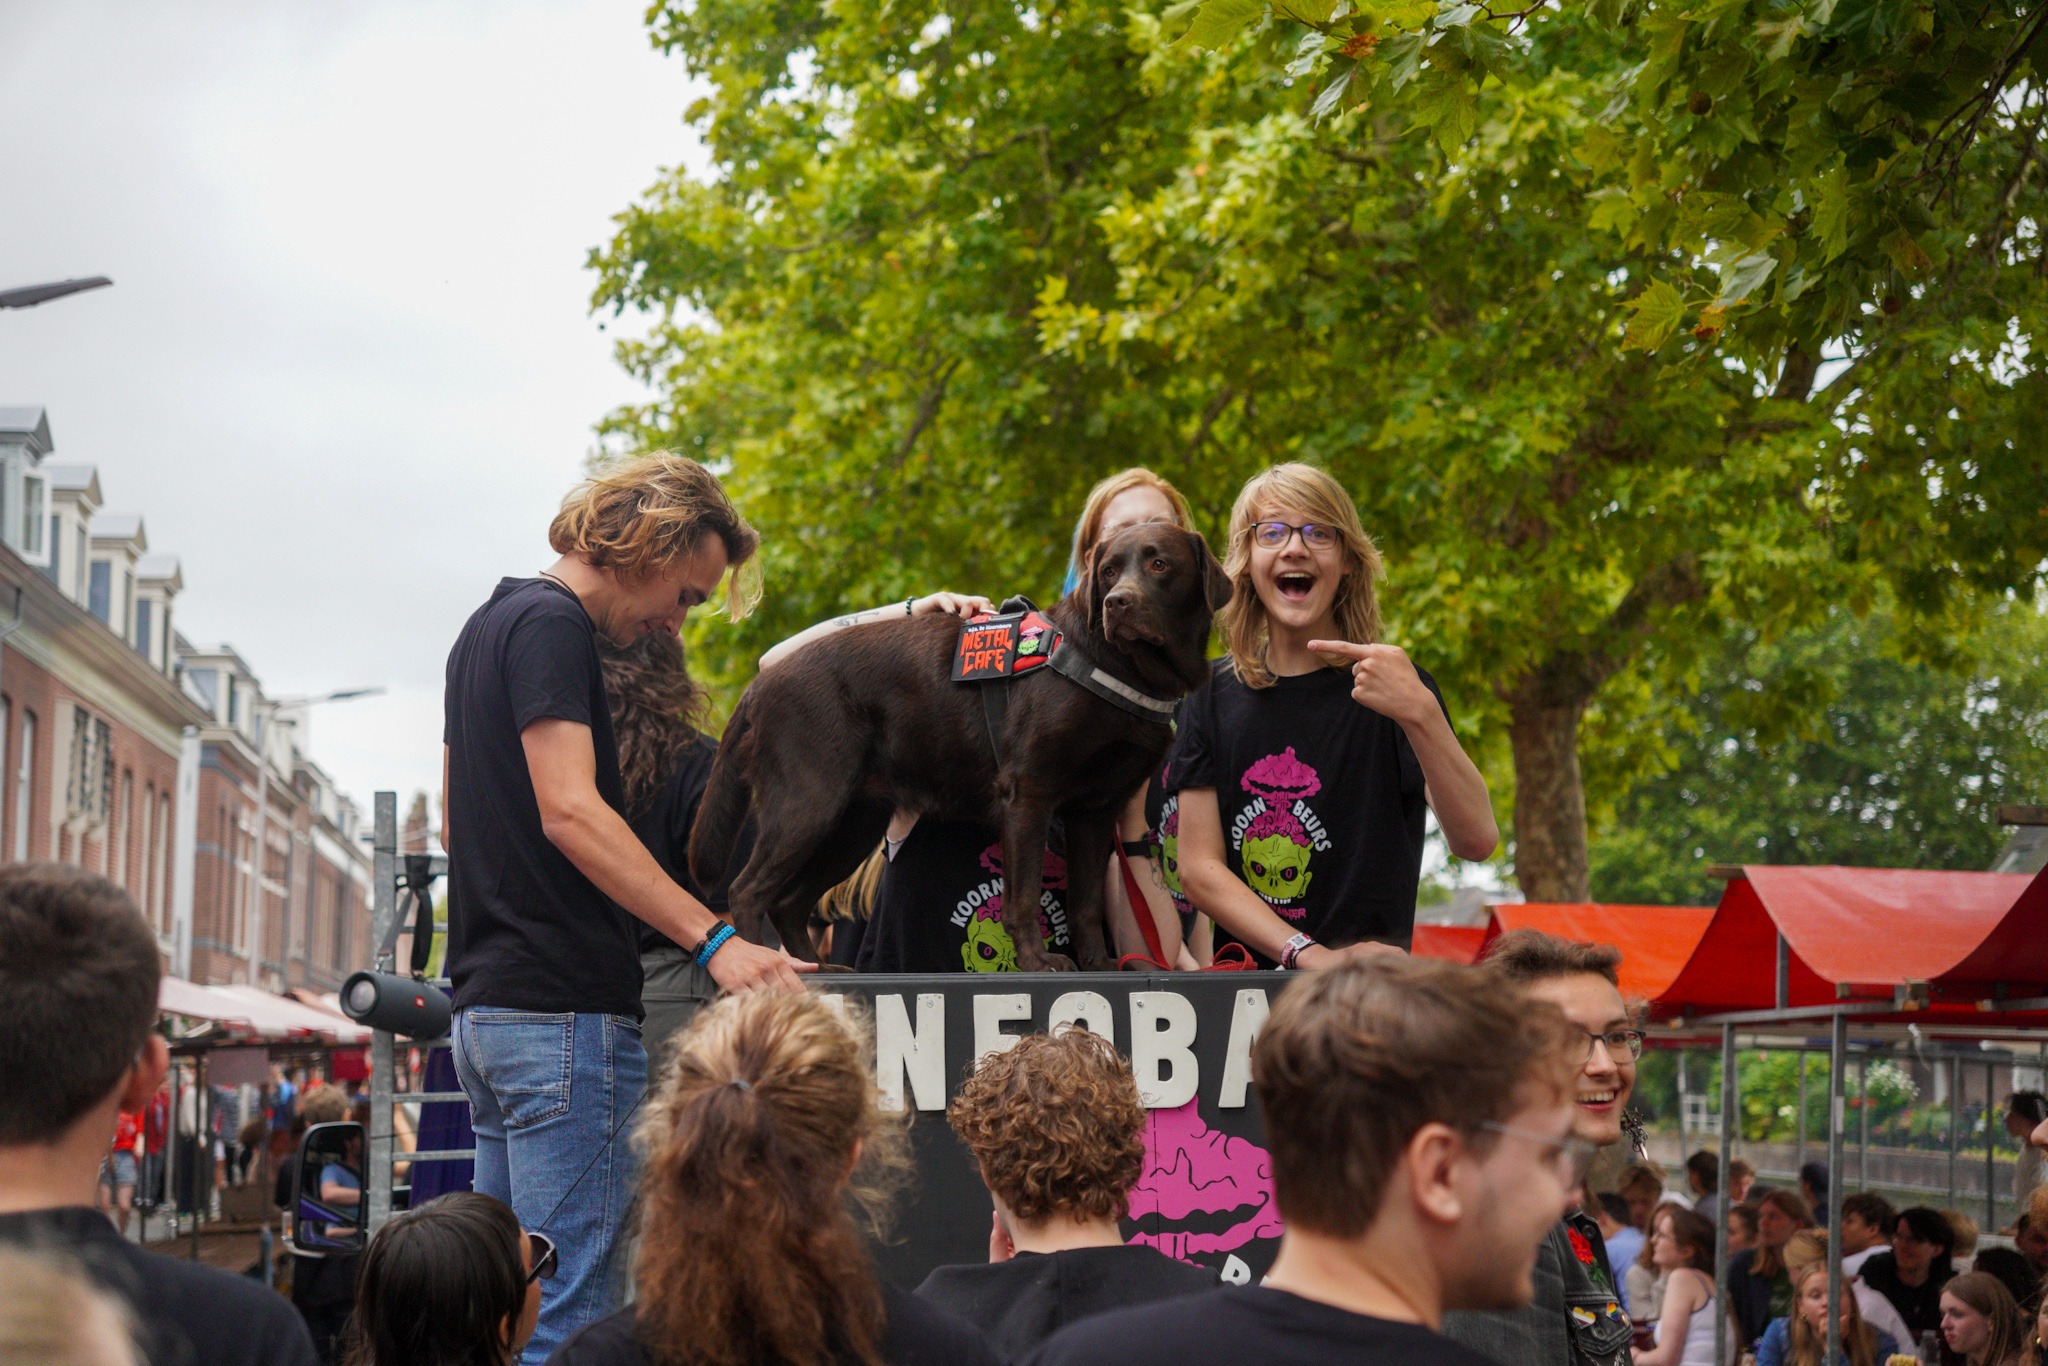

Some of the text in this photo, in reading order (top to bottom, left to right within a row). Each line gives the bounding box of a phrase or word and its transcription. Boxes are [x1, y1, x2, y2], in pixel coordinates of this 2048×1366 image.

[960, 628, 1013, 657] METAL
[962, 648, 1006, 676] CAFE
[1292, 799, 1332, 852] BEURS
[950, 877, 1070, 947] KOORN BEURS
